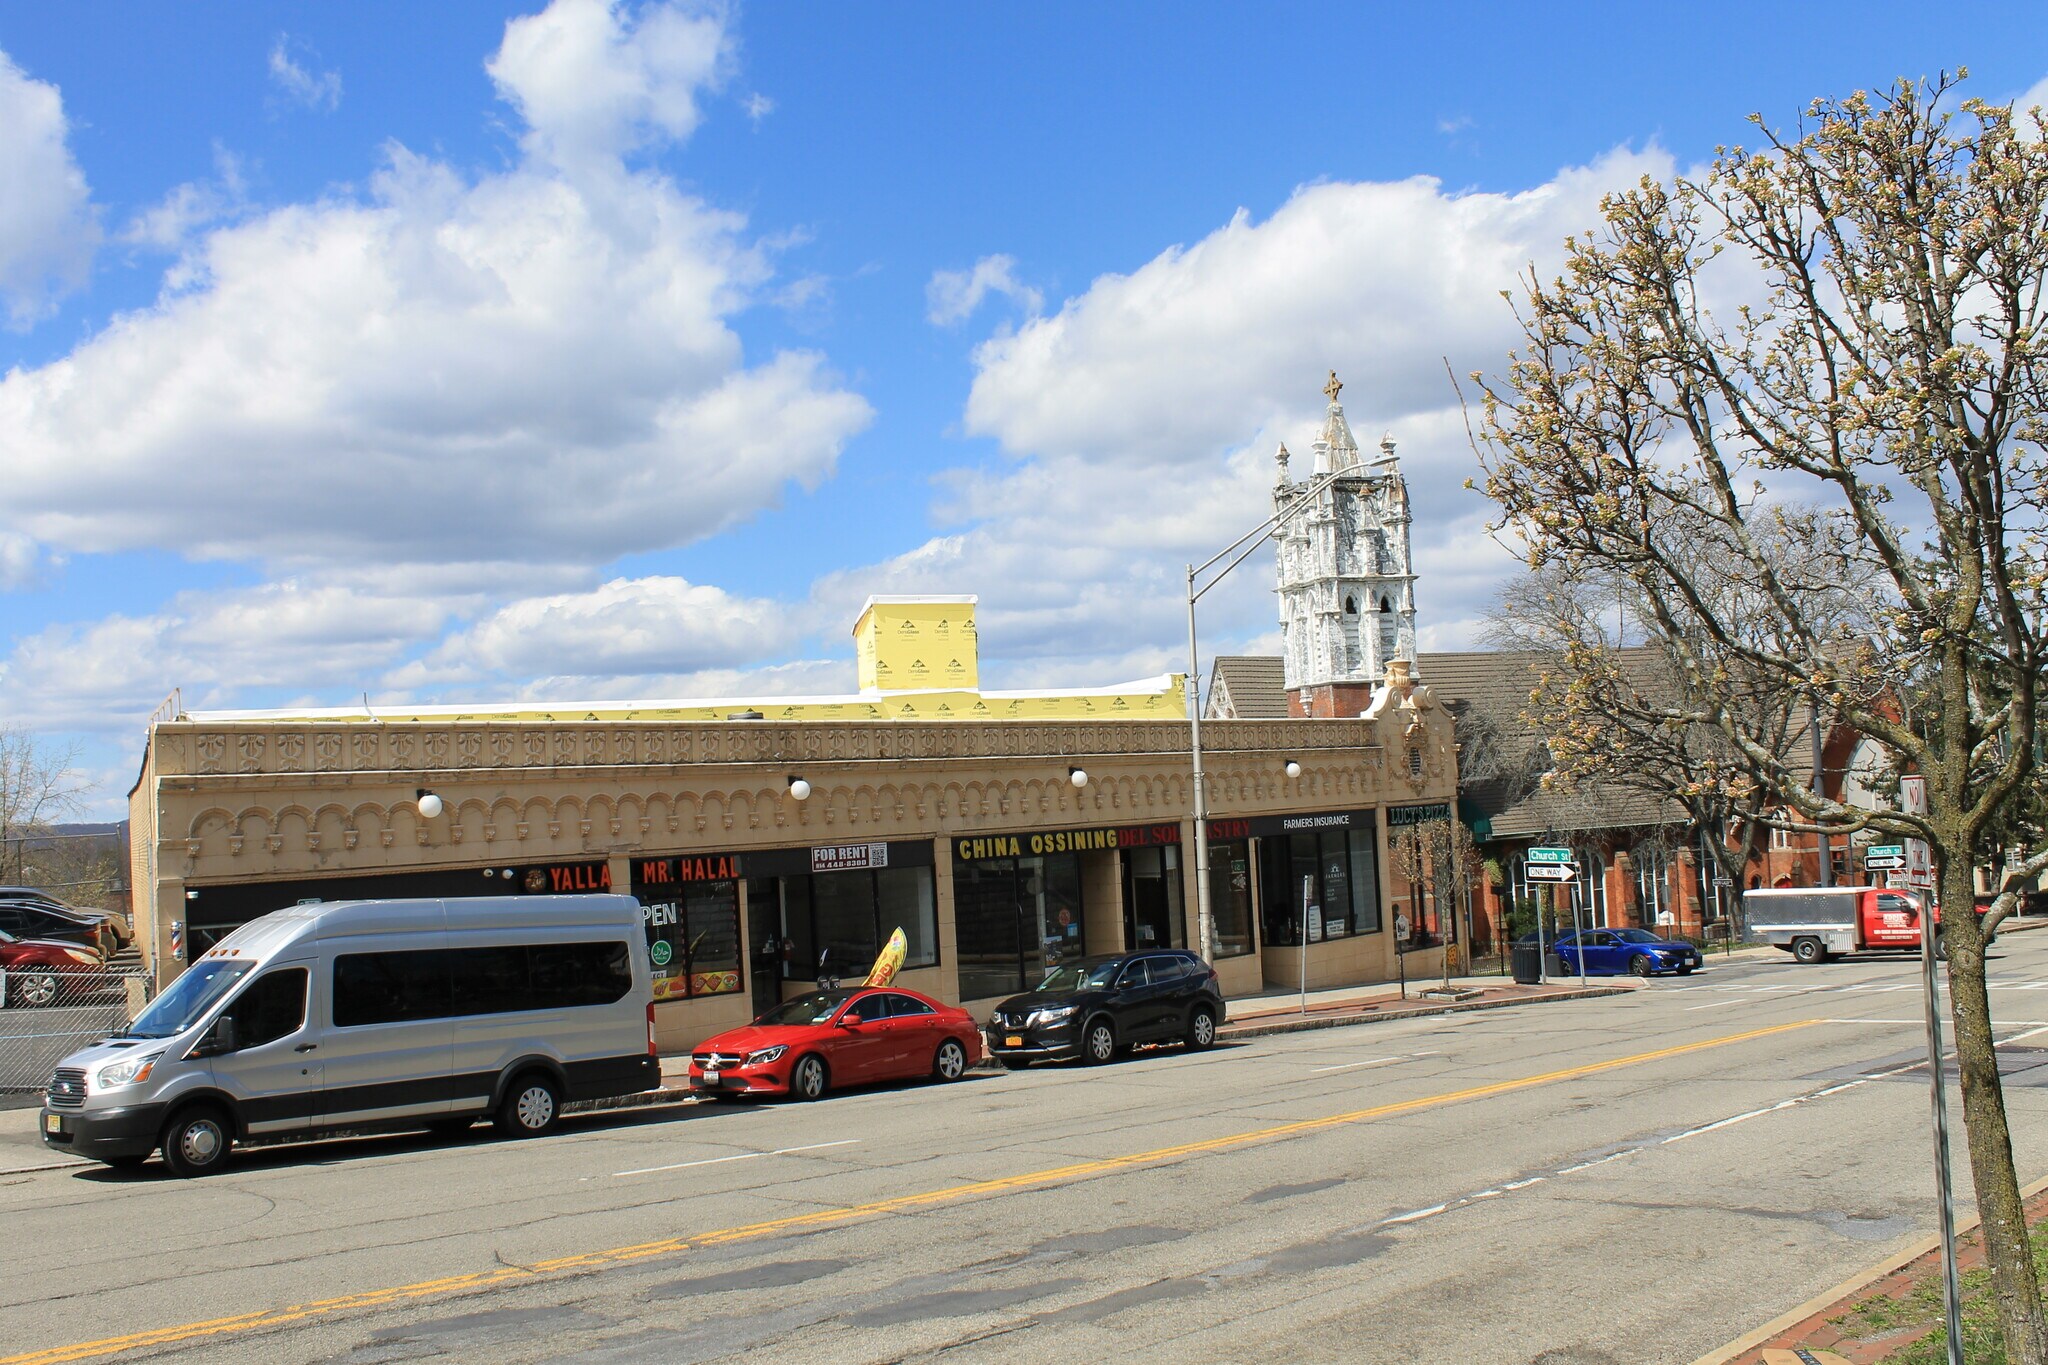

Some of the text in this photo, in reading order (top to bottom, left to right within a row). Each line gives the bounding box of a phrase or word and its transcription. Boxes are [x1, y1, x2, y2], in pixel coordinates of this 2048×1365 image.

[1909, 786, 1919, 807] NO
[1283, 815, 1350, 831] FARMERS INSURANCE
[1390, 806, 1424, 824] LUCY'S
[1118, 825, 1182, 847] DEL SOL
[1206, 821, 1250, 840] ASTRY
[813, 848, 837, 862] FOR
[838, 846, 867, 860] RENT
[960, 829, 1118, 860] CHINA OSSINING
[1870, 847, 1892, 855] Church
[1531, 850, 1569, 861] Church St
[551, 865, 612, 891] YALLA
[643, 856, 739, 884] MR. HALAL
[1530, 868, 1561, 876] ONE WAY
[640, 902, 677, 927] PEN
